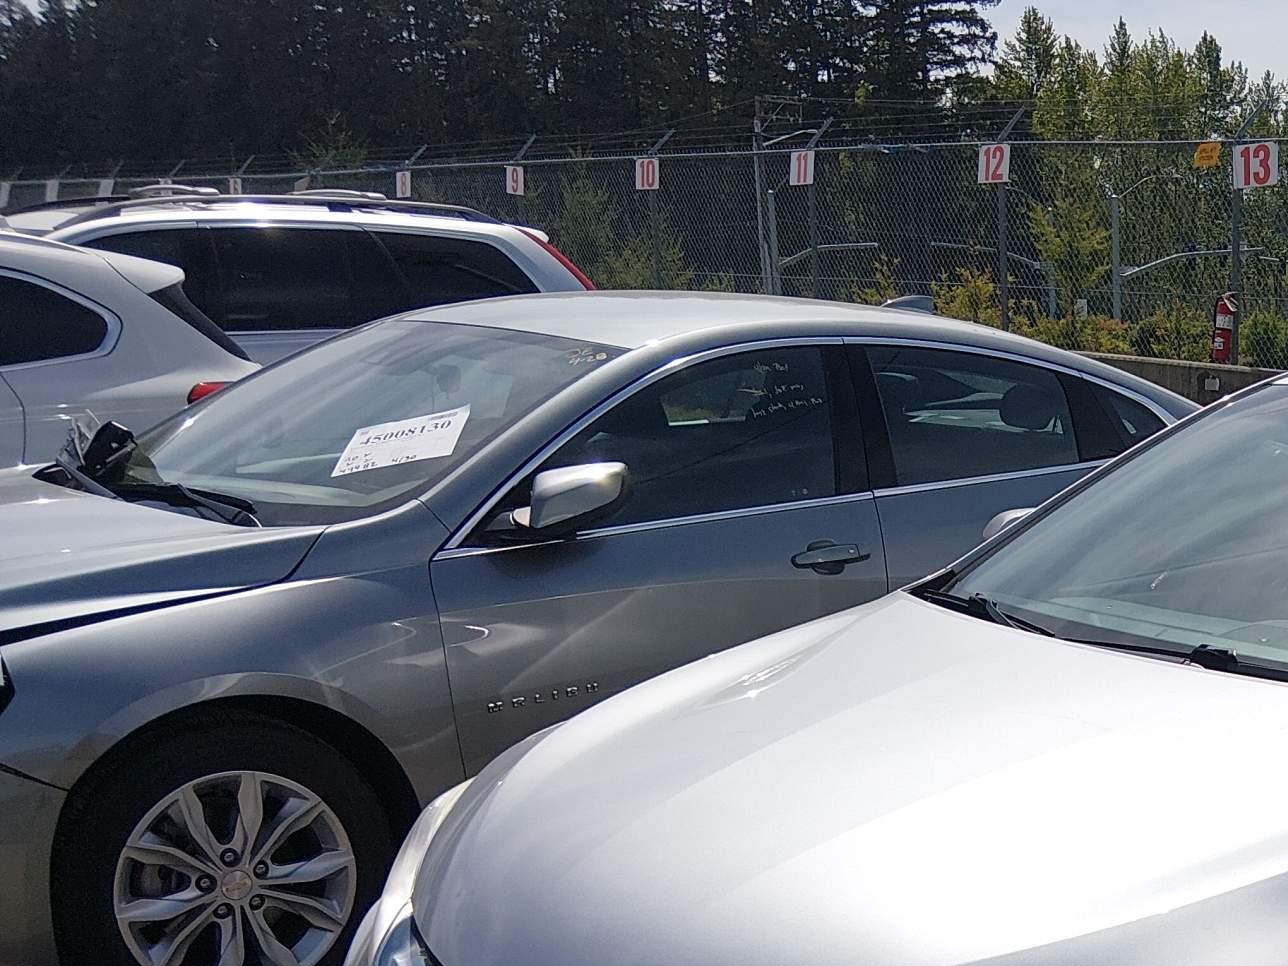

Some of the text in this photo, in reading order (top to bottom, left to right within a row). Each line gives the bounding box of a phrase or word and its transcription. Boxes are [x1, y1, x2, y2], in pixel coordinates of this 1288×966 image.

[639, 159, 657, 188] 10
[796, 153, 808, 183] 11
[983, 145, 1005, 181] 12
[1240, 143, 1271, 186] 13
[399, 172, 408, 196] 8
[511, 166, 519, 193] 9
[360, 420, 452, 445] 45008130
